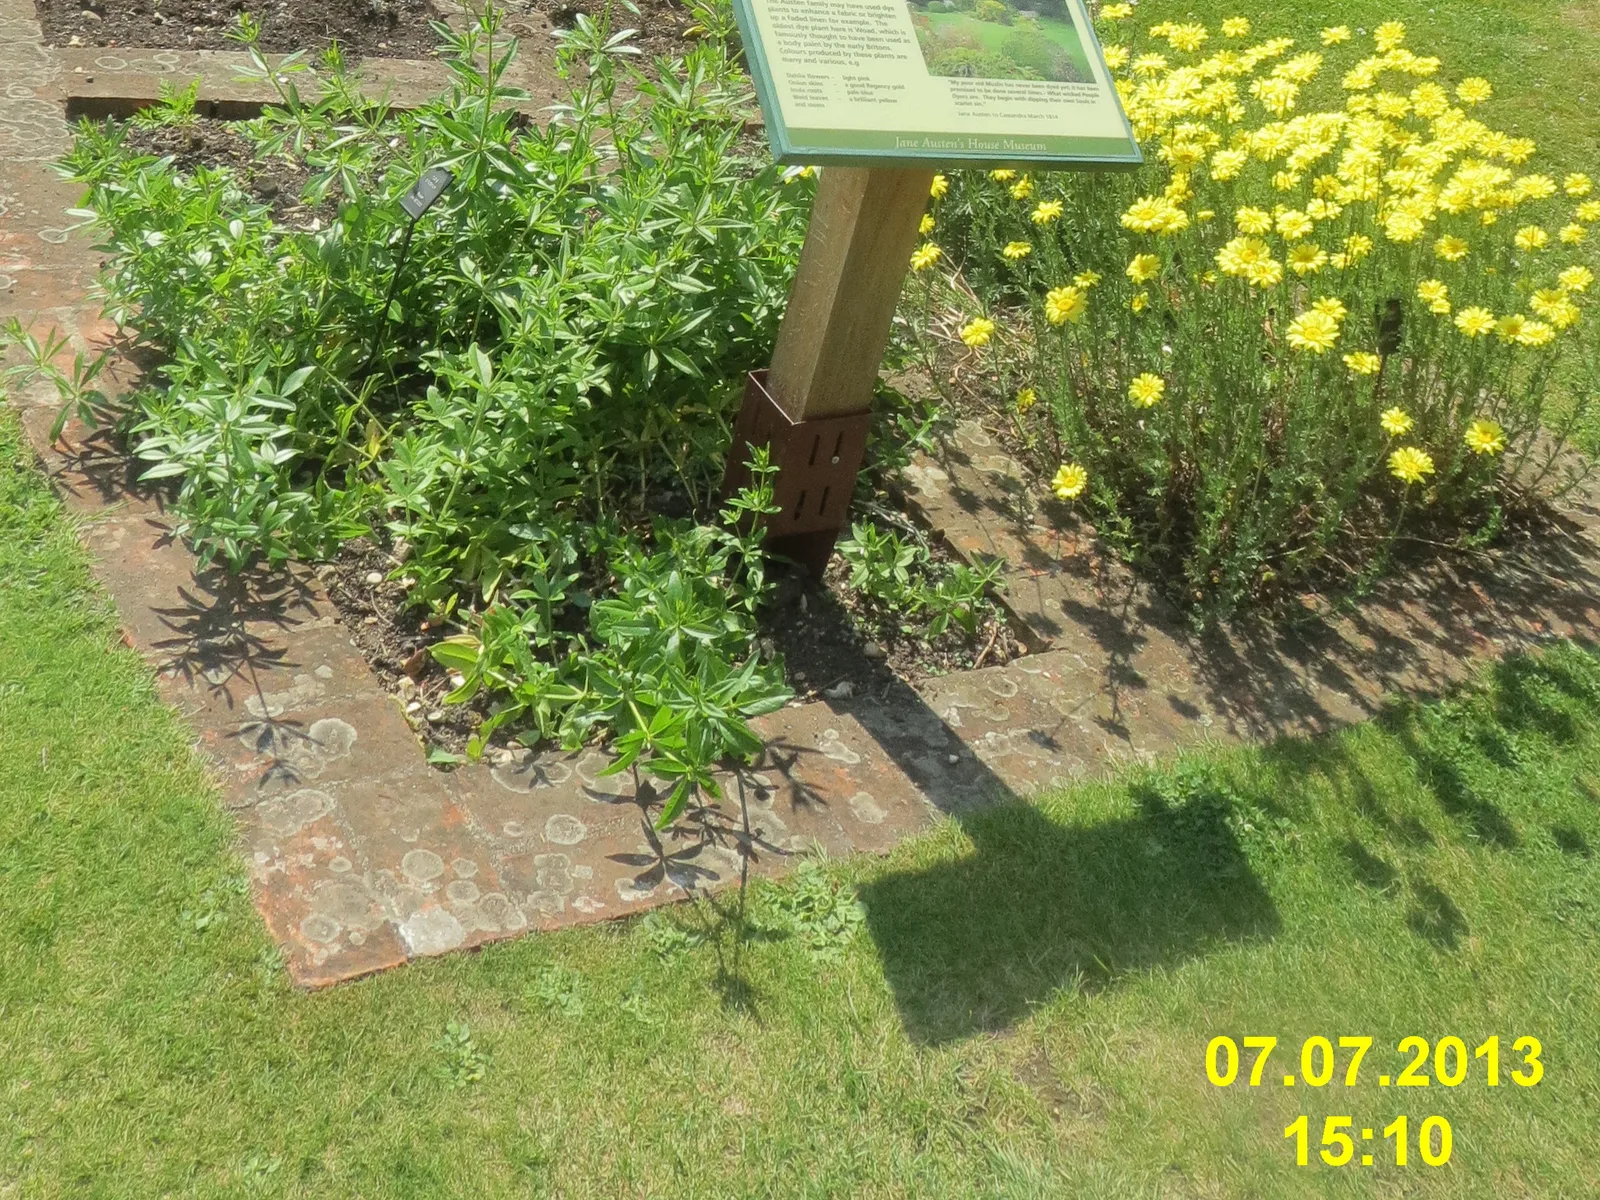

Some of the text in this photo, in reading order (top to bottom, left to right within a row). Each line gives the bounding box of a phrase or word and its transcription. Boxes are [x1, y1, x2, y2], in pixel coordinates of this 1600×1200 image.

[807, 0, 828, 8] family
[774, 31, 807, 39] famously
[874, 52, 894, 60] plants
[820, 58, 847, 66] various,
[896, 137, 1046, 150] Jane Austen's House Museum
